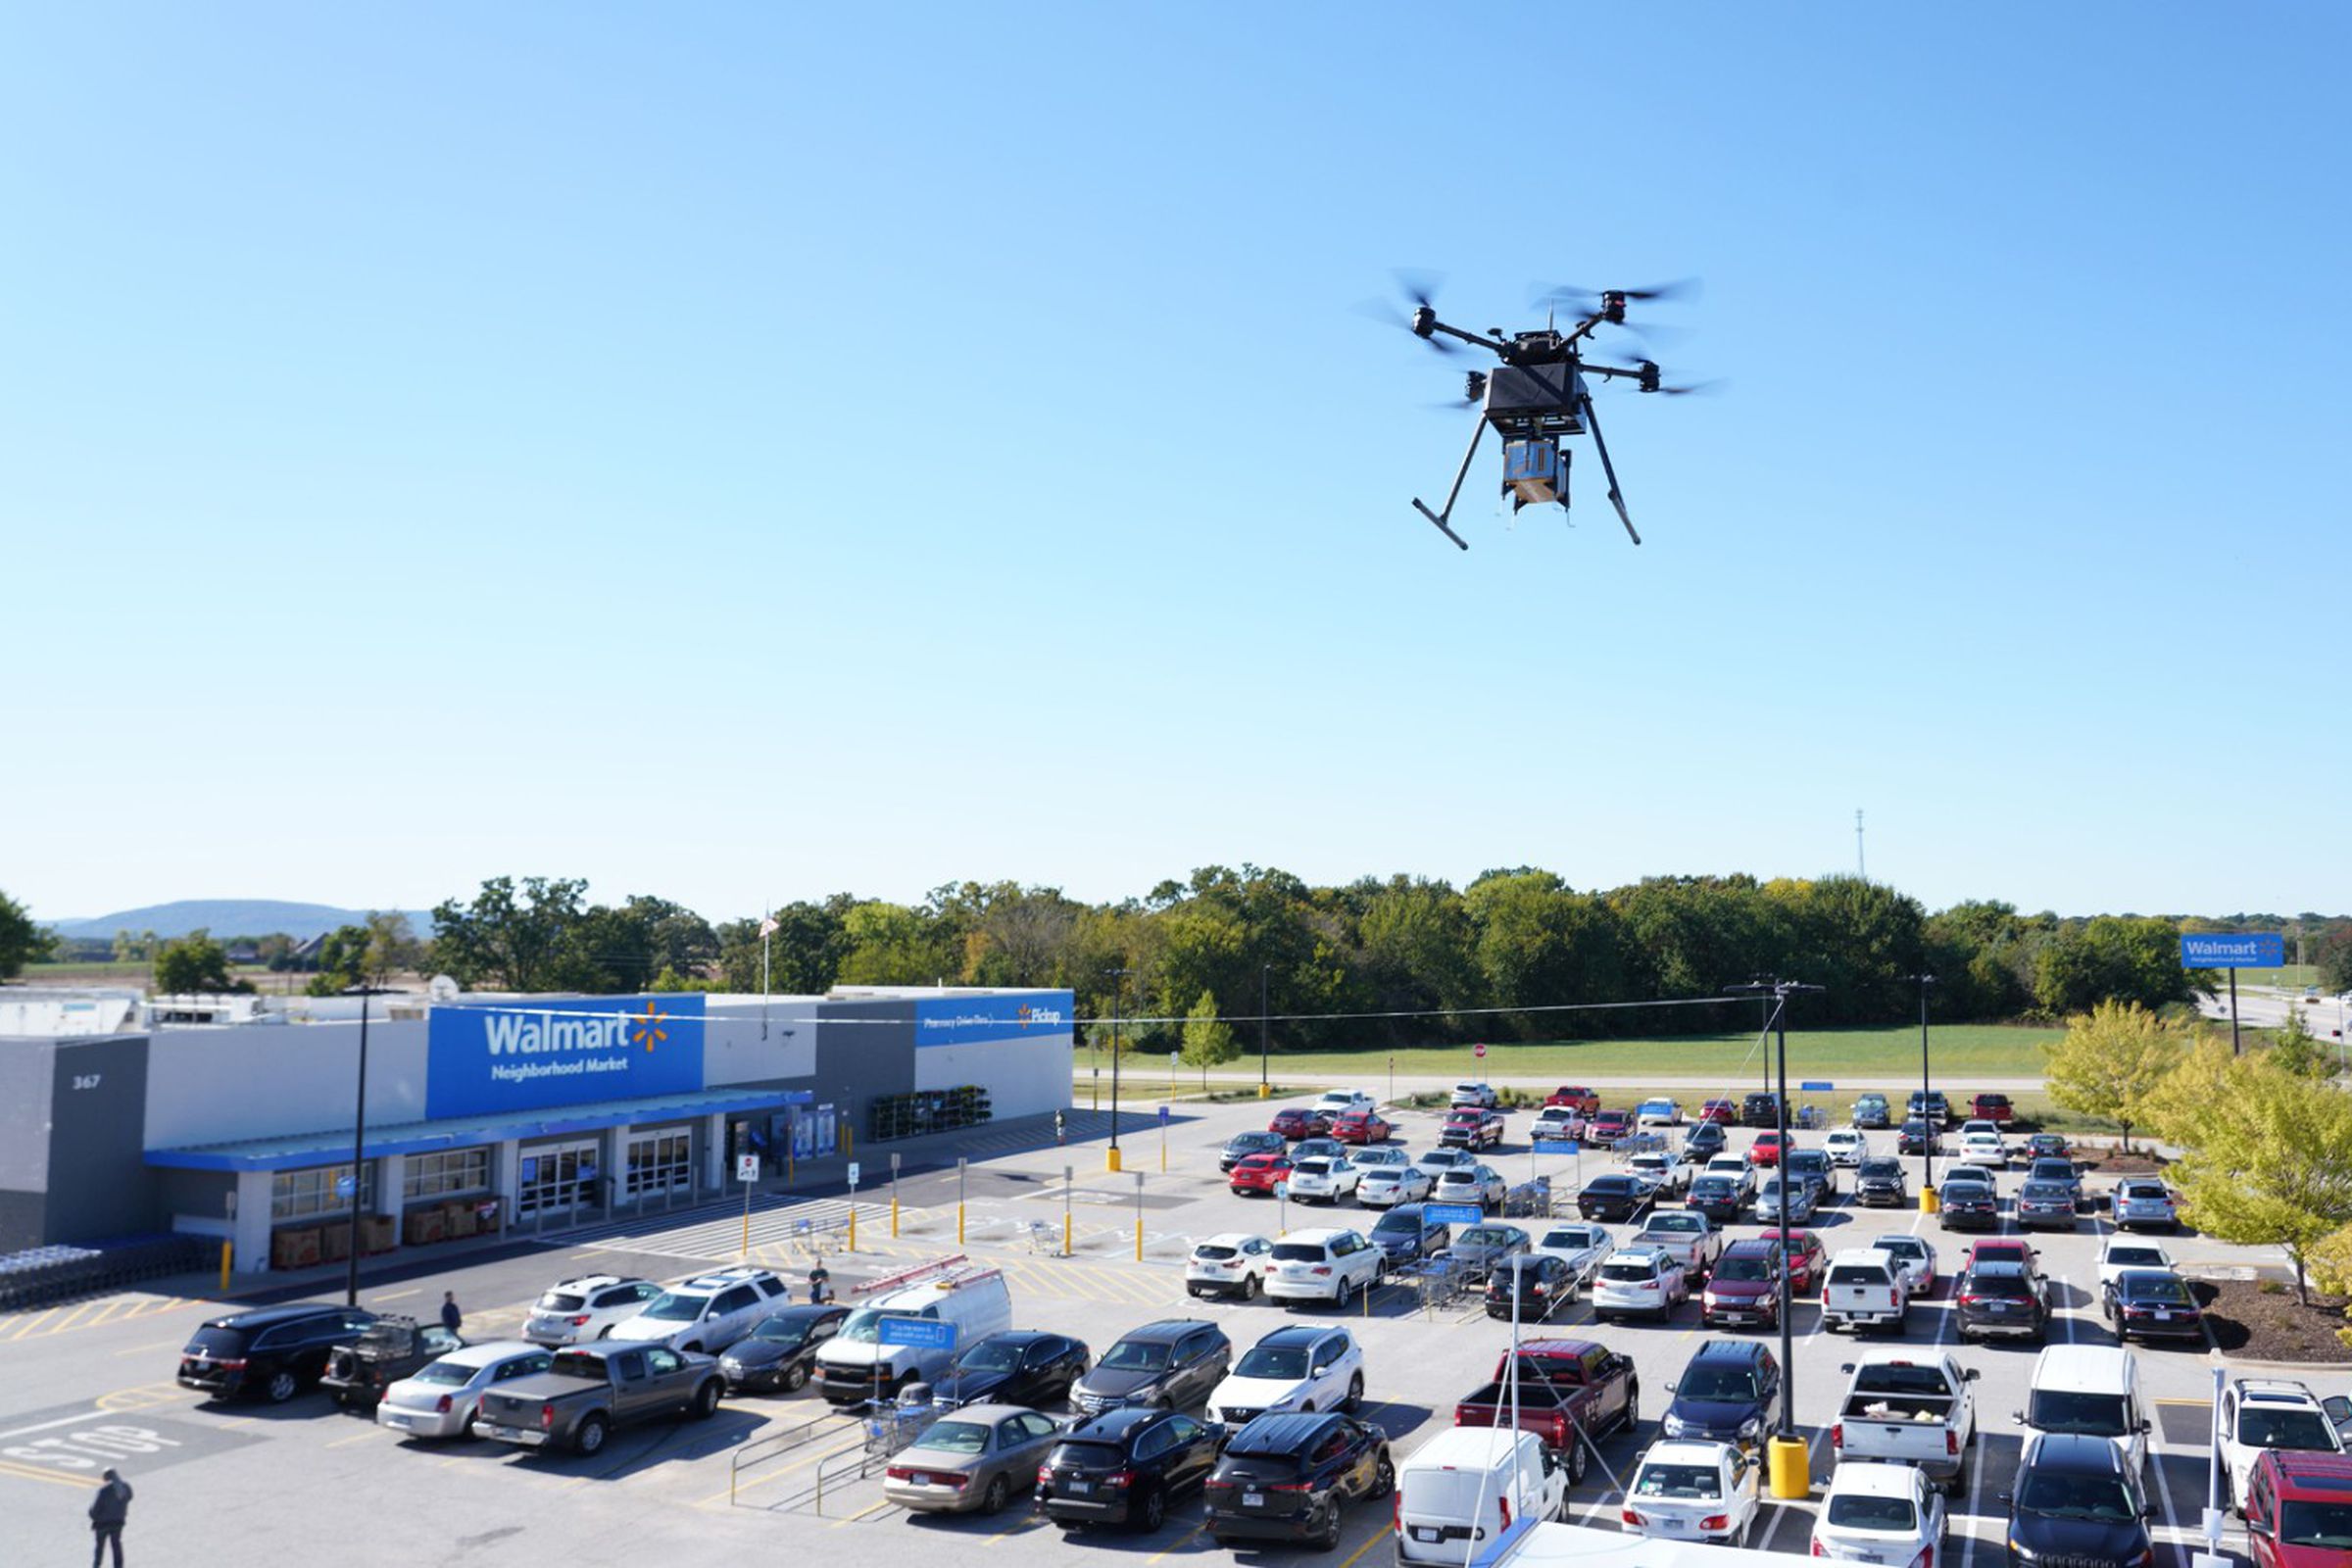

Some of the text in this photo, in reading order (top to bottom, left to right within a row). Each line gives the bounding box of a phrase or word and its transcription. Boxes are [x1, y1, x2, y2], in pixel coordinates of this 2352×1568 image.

[2186, 941, 2257, 955] Walmart
[1032, 1007, 1060, 1026] Pickup
[484, 1009, 630, 1055] Walmart
[492, 1055, 628, 1083] Neighborhood Market
[73, 1074, 101, 1090] 367
[2, 1425, 182, 1468] STOP
